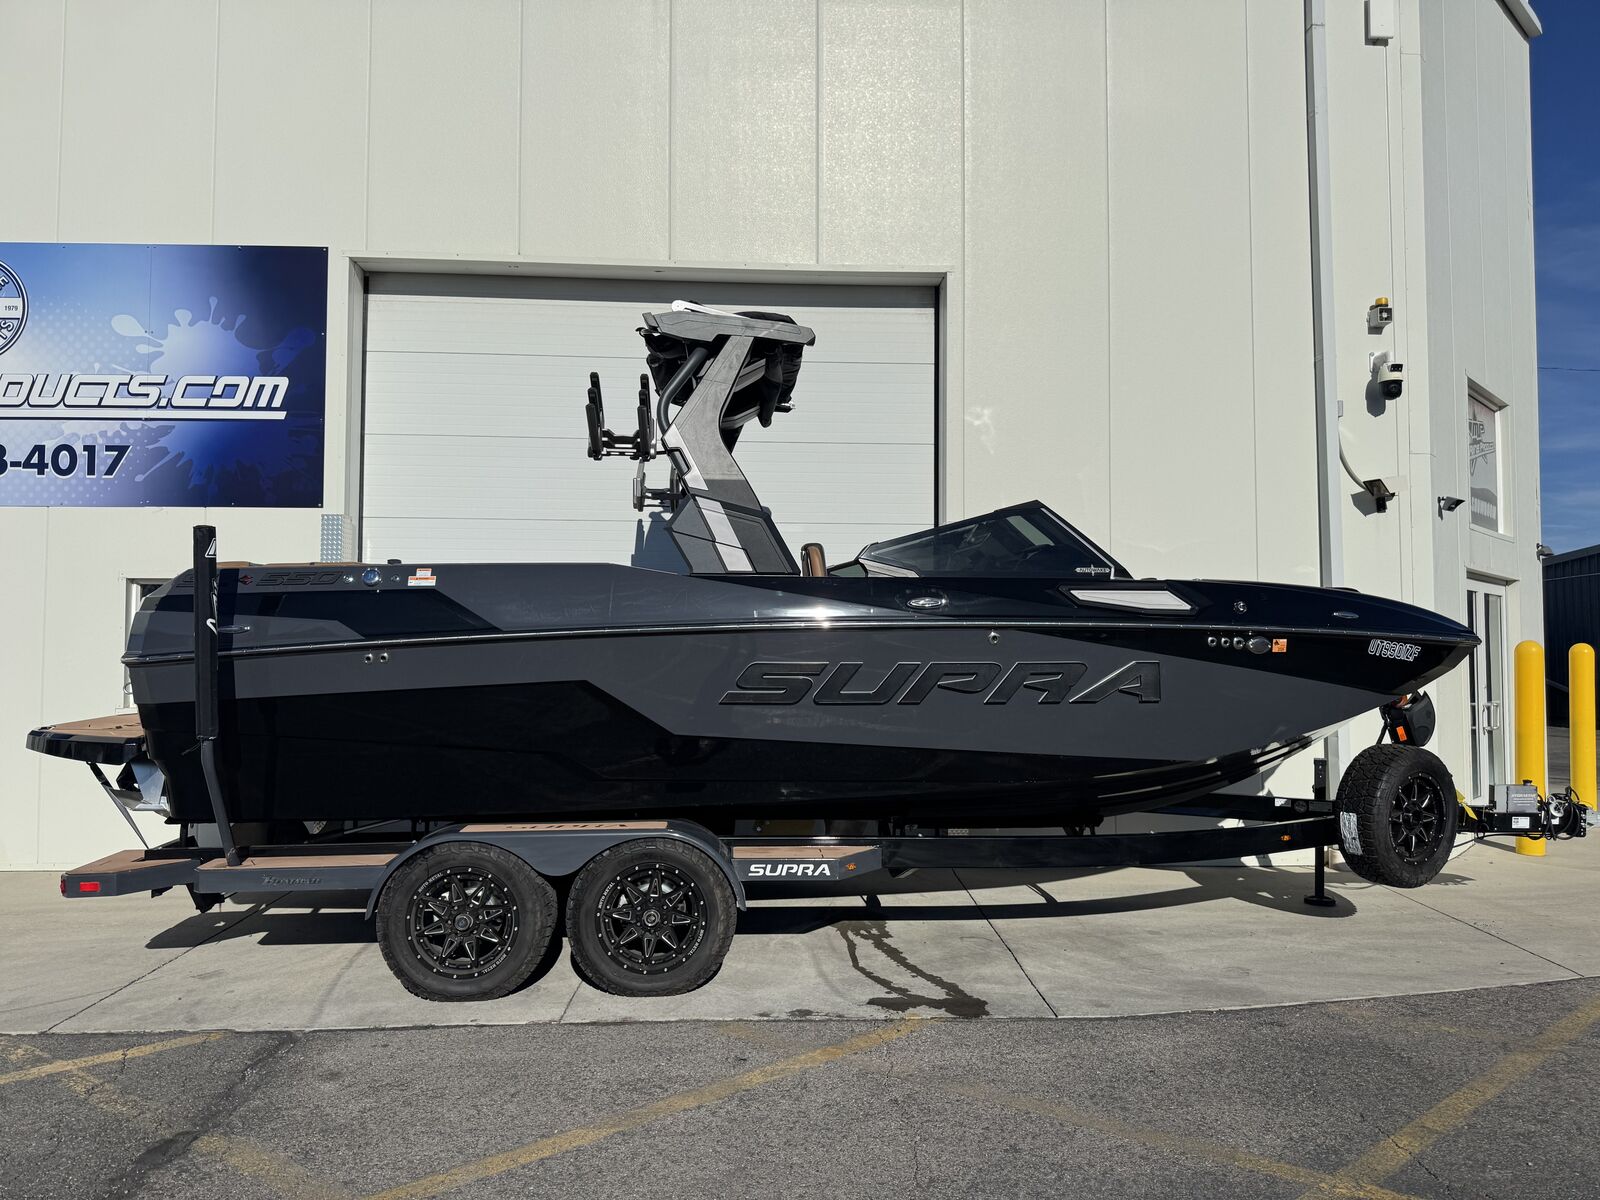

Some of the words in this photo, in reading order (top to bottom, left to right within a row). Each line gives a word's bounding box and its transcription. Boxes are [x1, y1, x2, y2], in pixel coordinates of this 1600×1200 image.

[255, 571, 343, 587] 550
[718, 660, 1162, 706] SUPRA
[747, 863, 832, 877] SUPRA
